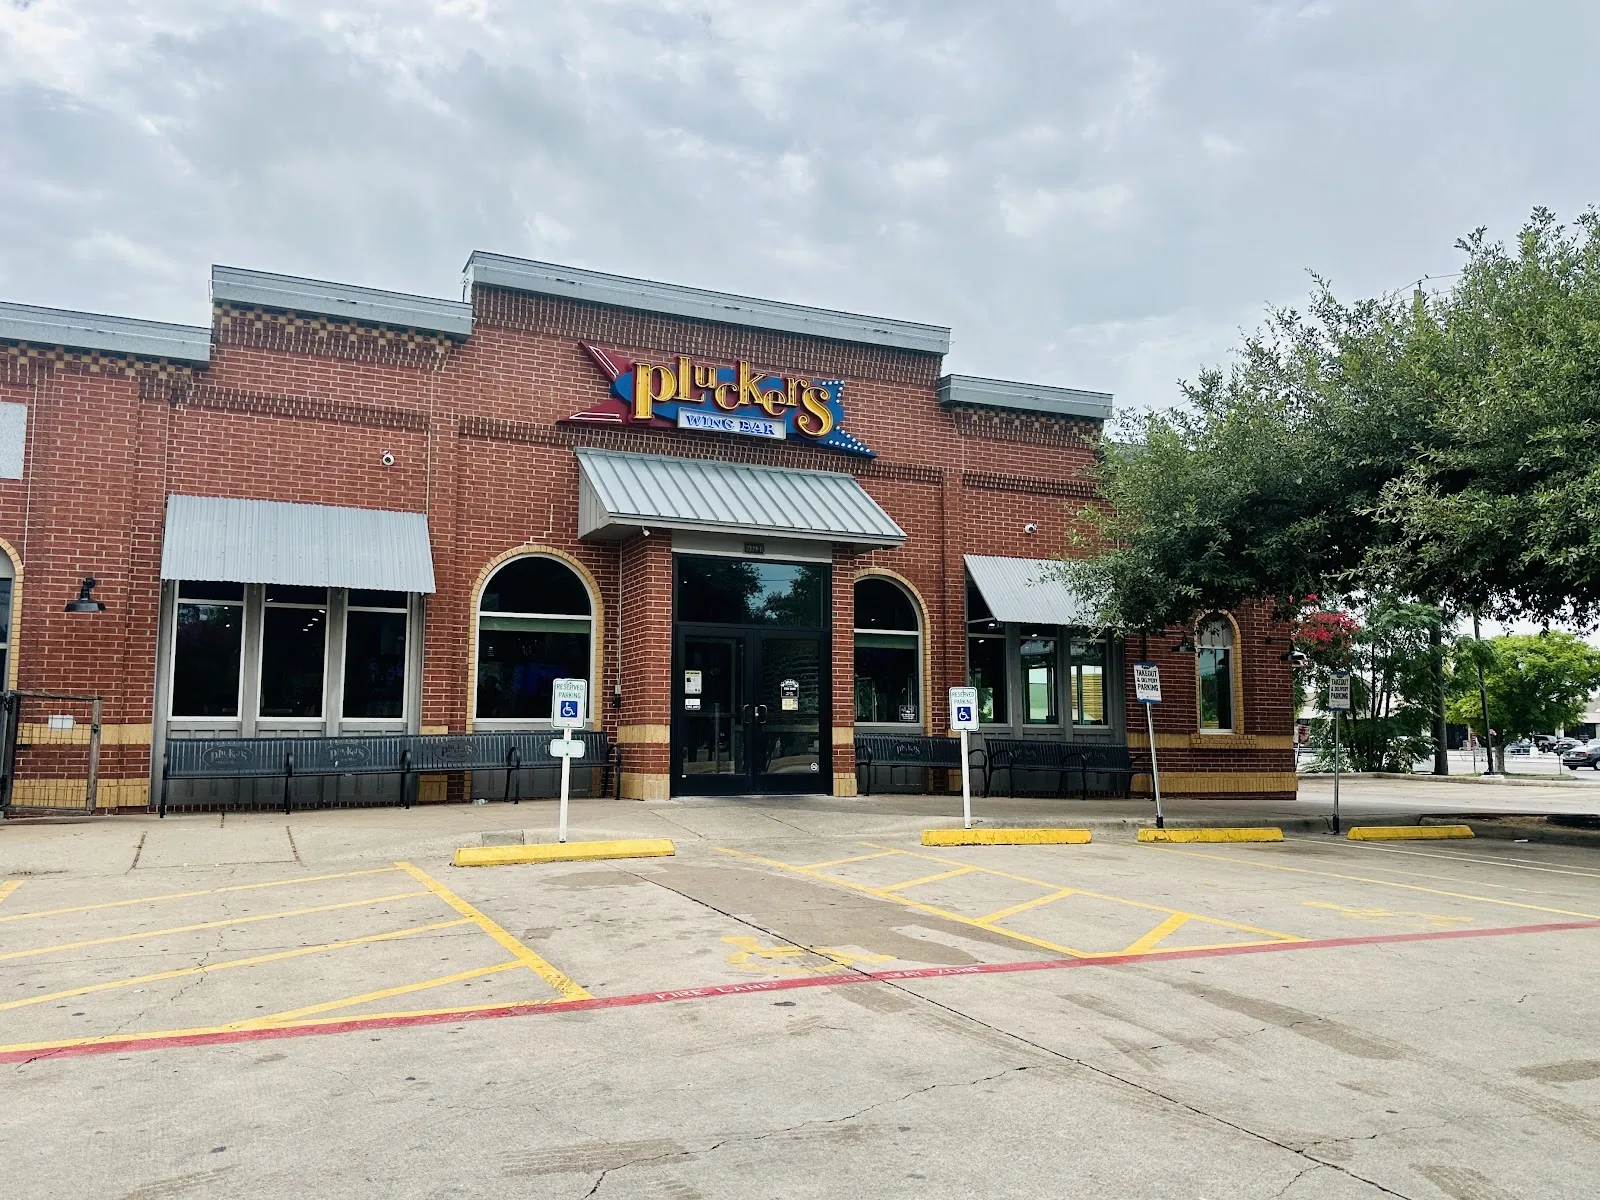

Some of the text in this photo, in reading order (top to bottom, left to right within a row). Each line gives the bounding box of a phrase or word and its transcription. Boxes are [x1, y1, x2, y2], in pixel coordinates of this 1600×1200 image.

[685, 414, 775, 436] WING BAR
[655, 989, 709, 1001] FIRE
[715, 981, 778, 994] LANE
[932, 966, 987, 976] ZONE
